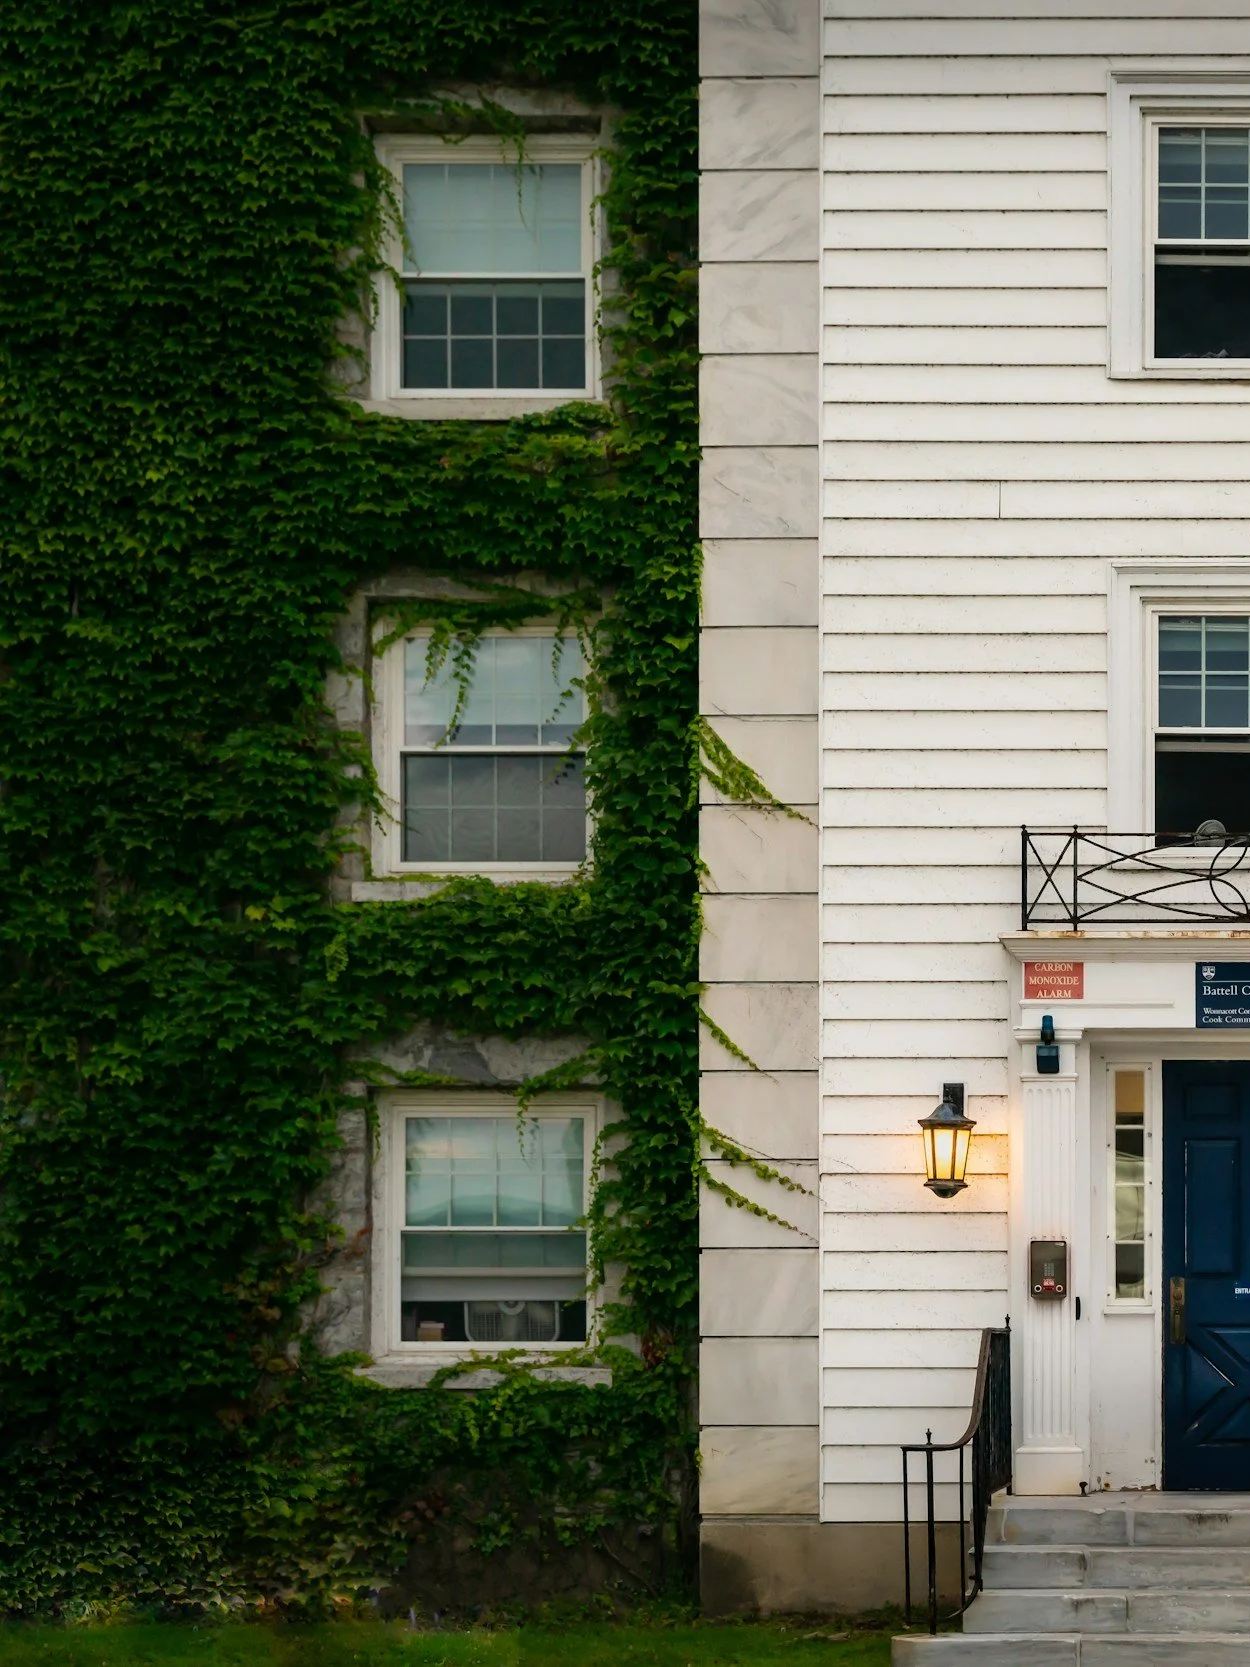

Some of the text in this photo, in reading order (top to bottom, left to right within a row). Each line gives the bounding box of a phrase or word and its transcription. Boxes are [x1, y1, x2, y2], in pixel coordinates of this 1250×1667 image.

[1034, 963, 1073, 972] CARBON
[1028, 976, 1080, 985] MONOXIDE
[1036, 989, 1072, 999] ALARM
[1202, 984, 1238, 996] Battell
[1202, 1015, 1223, 1024] Cook
